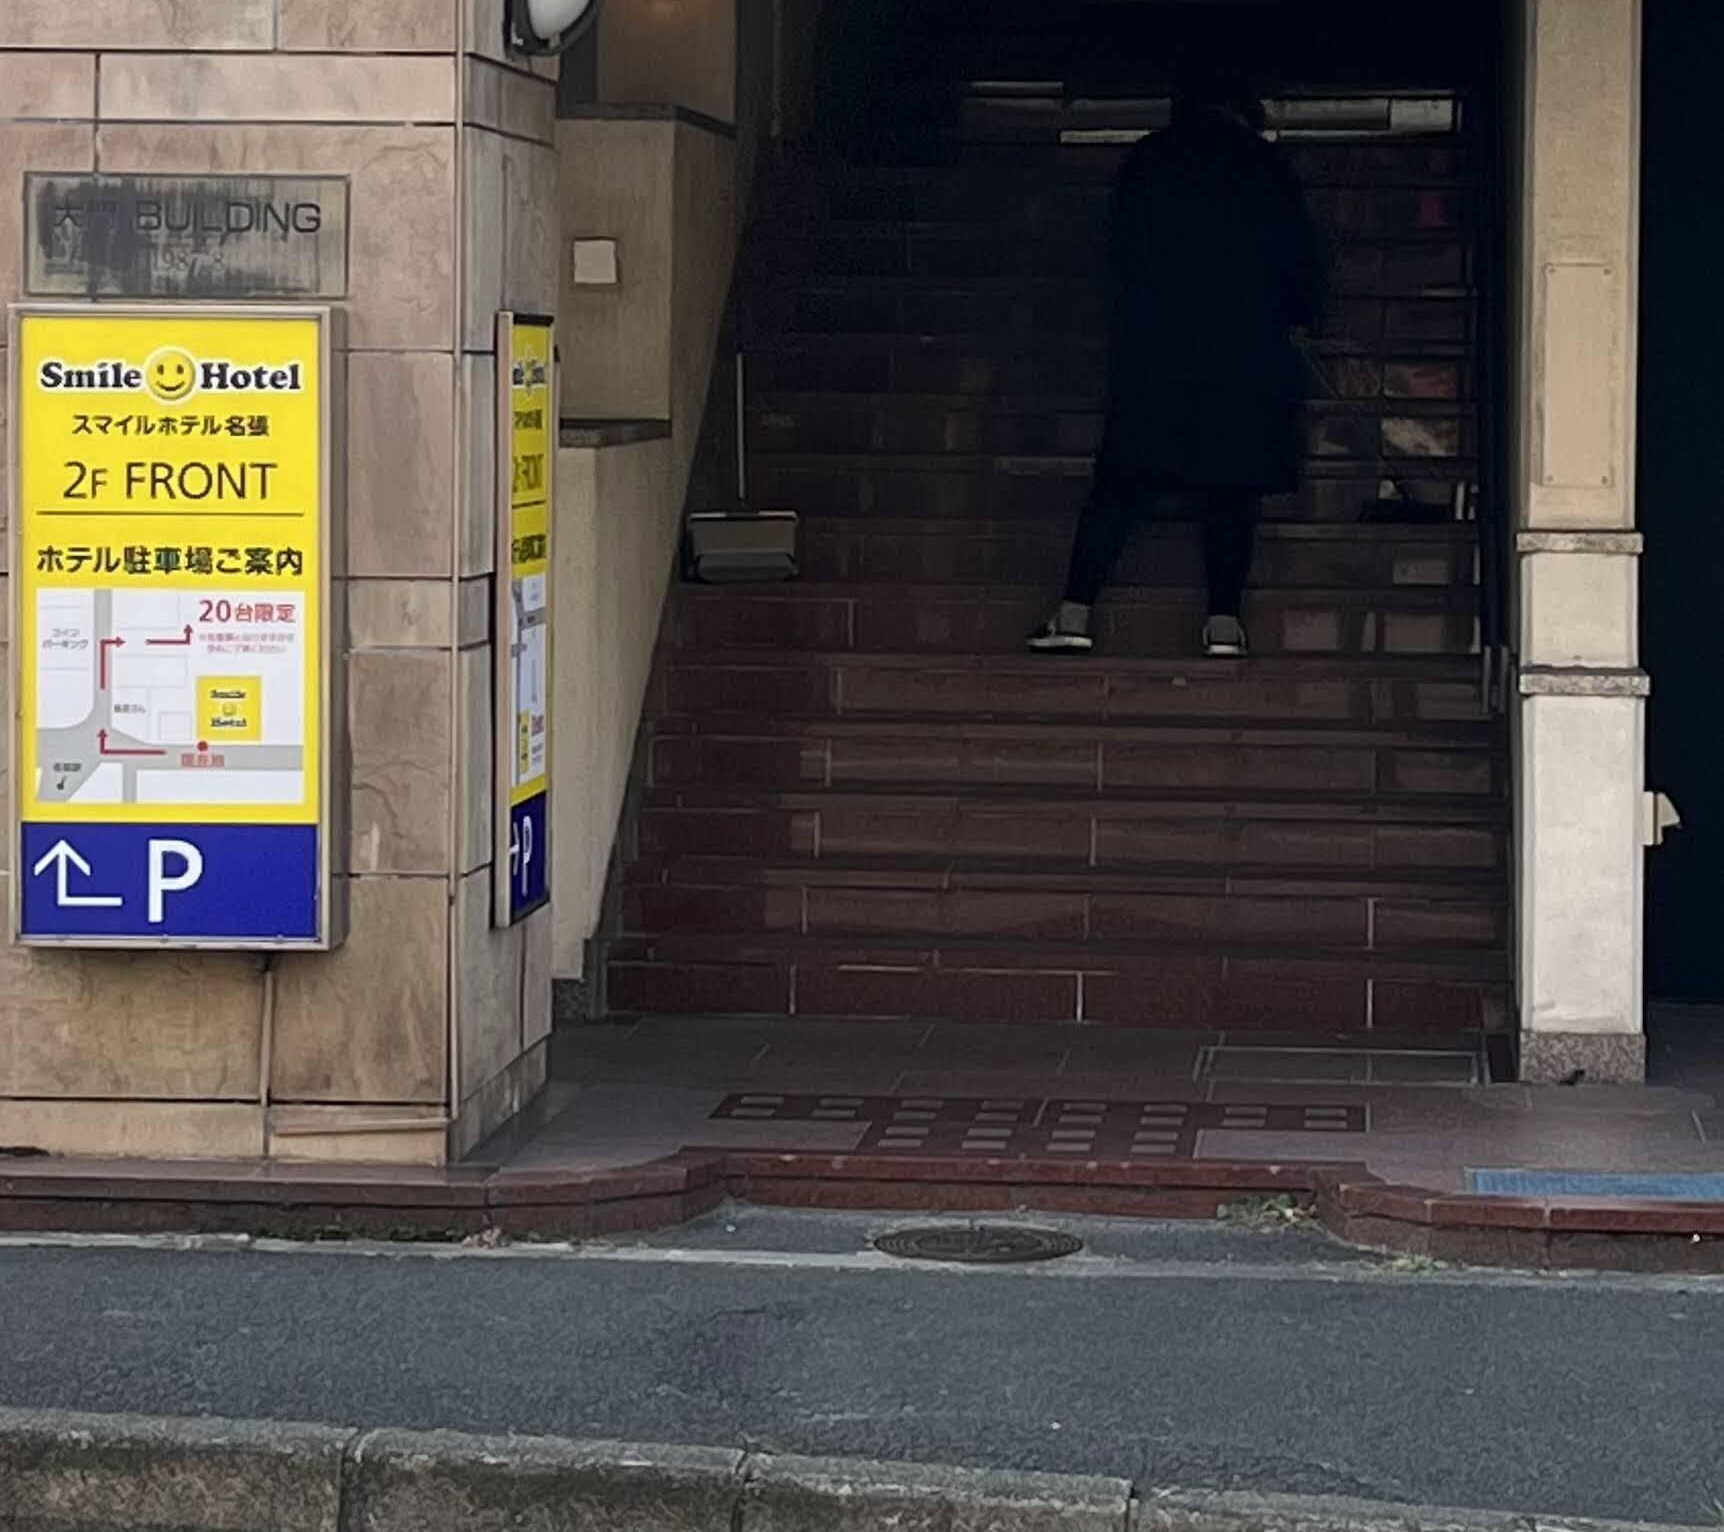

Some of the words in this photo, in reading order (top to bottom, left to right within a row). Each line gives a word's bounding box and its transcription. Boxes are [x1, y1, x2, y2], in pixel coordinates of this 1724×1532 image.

[135, 201, 322, 234] BUILDING
[40, 361, 142, 389] Smile
[200, 362, 301, 390] Hotel
[72, 414, 270, 437] スマイルホテル名張
[63, 461, 107, 499] 2F
[126, 462, 278, 500] FRONT
[37, 545, 303, 576] ホテル駐車場ご案内
[198, 599, 296, 624] 20台限定
[148, 839, 204, 923] P
